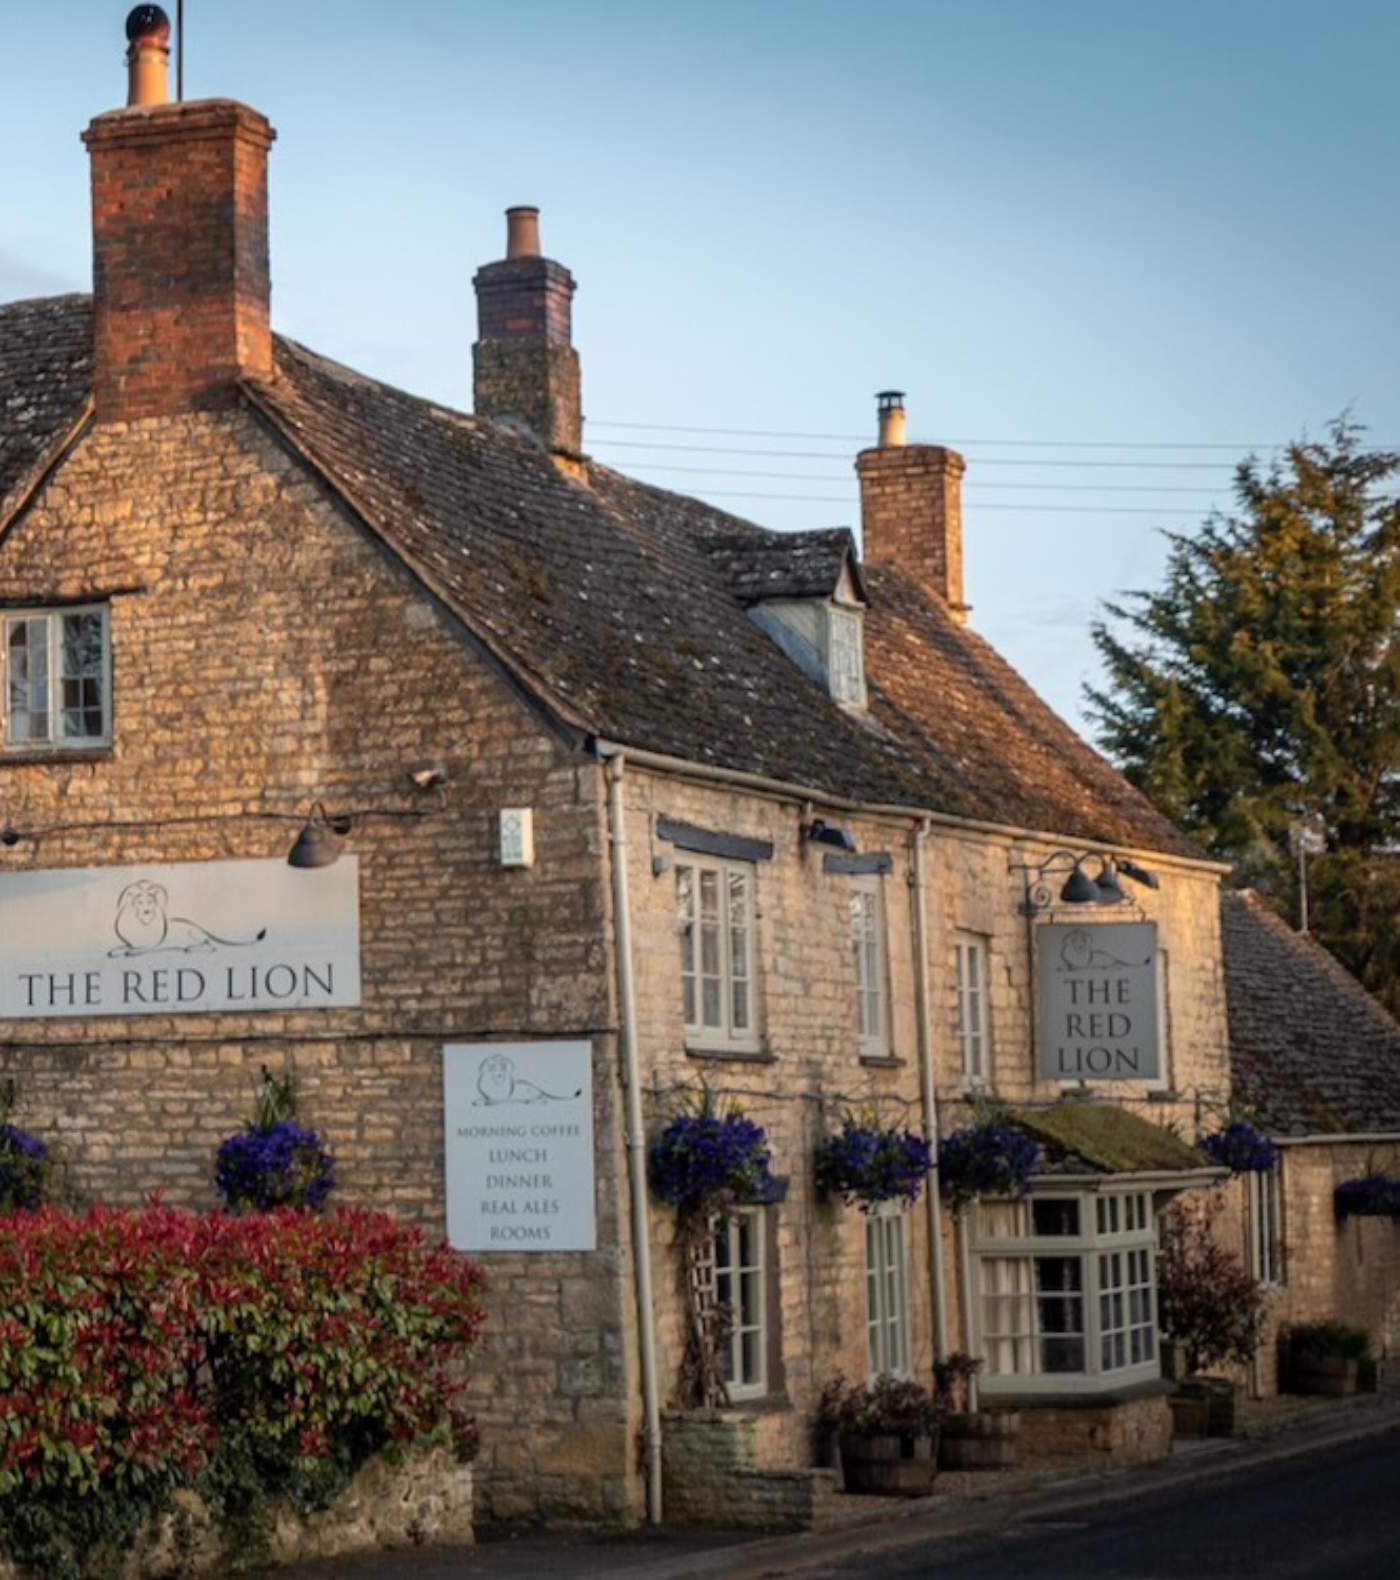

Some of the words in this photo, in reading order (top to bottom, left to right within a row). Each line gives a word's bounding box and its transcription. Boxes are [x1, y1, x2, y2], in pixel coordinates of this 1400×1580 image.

[18, 971, 101, 1006] THE
[122, 967, 206, 1004] RED
[225, 963, 334, 1000] LION
[1063, 978, 1131, 1005] THE
[1066, 1012, 1132, 1039] RED
[1057, 1046, 1140, 1074] LION
[456, 1125, 527, 1139] MORNING
[531, 1123, 581, 1138] COFFEE
[488, 1148, 548, 1164] LUNCH
[485, 1173, 553, 1189] DINNER
[480, 1199, 518, 1215] REAL
[522, 1199, 560, 1214] ALES
[489, 1225, 551, 1241] ROOMS
